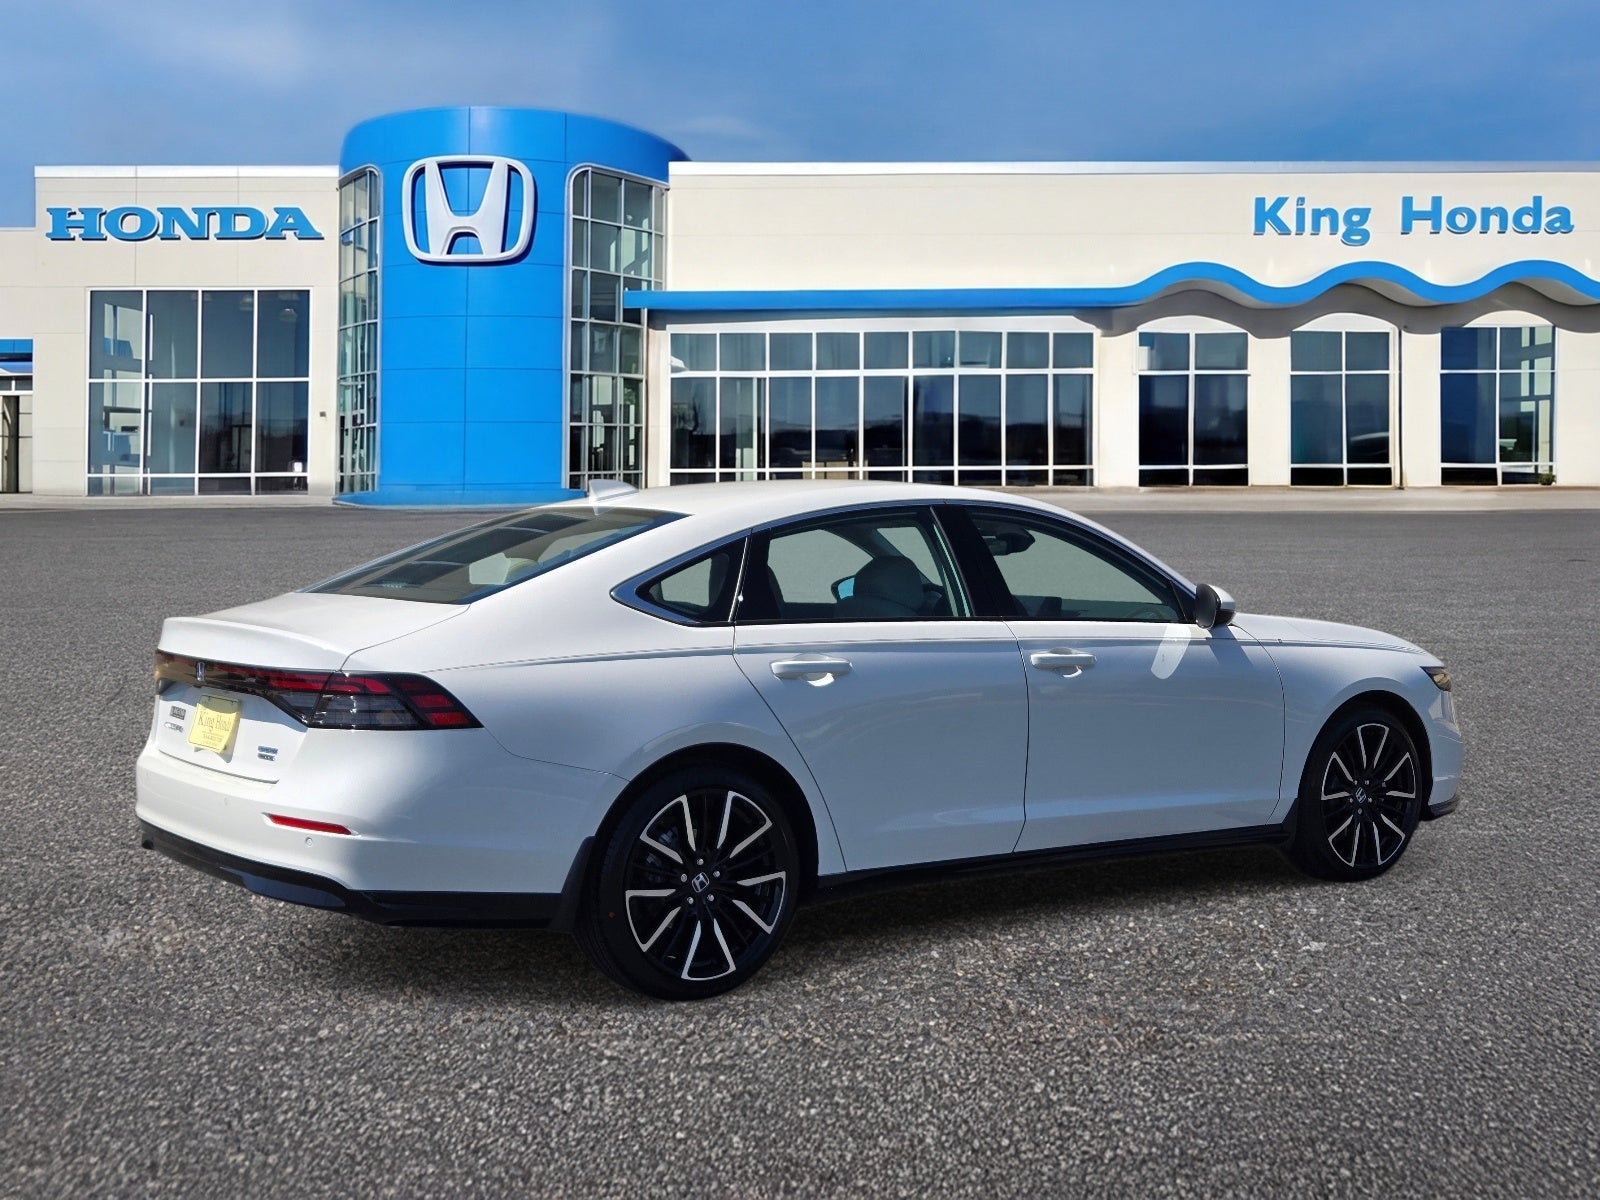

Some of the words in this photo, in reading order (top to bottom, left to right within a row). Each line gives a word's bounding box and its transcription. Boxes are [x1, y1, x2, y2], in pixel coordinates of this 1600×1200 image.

[46, 206, 324, 242] HONDA
[1254, 196, 1372, 246] King
[1401, 195, 1575, 235] Honda
